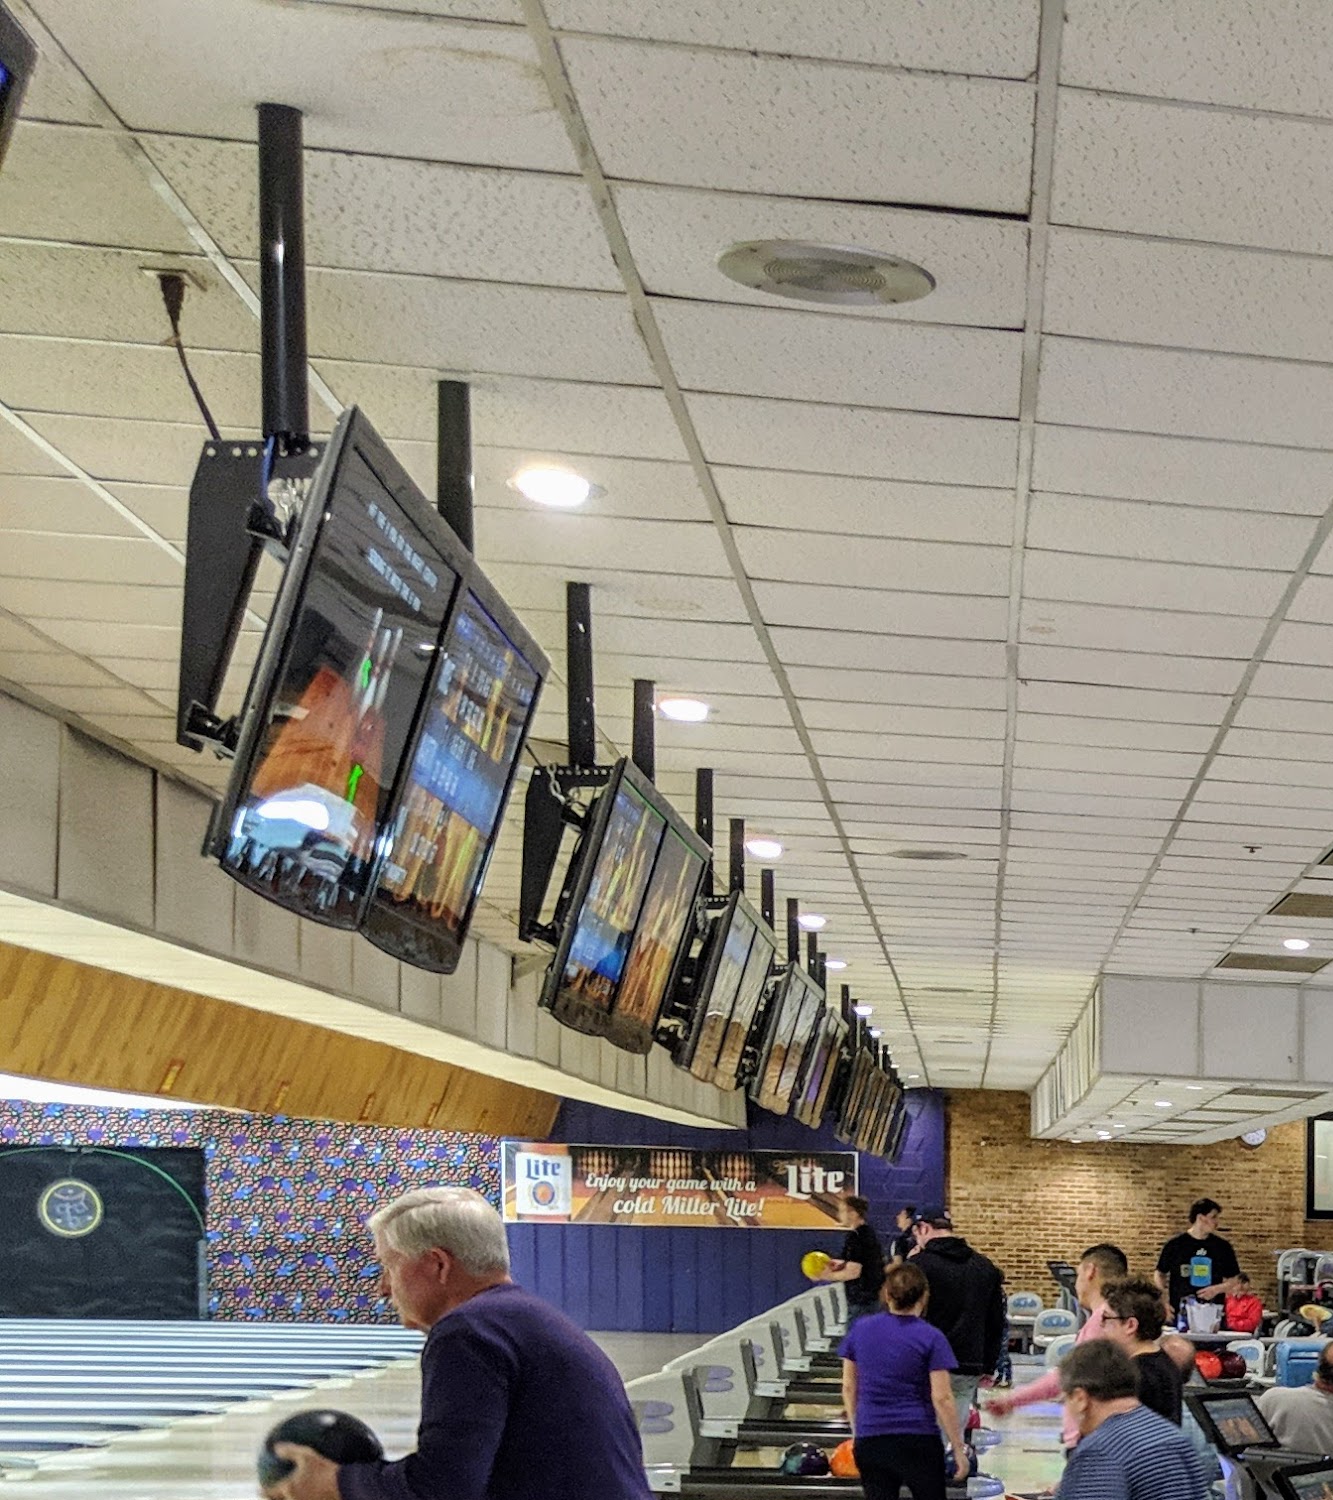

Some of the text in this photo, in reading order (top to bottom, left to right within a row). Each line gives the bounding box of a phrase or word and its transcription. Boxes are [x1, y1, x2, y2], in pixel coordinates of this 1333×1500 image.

[526, 1158, 561, 1180] Lite
[585, 1172, 757, 1193] Enjoy your game with a
[785, 1164, 845, 1200] Lite
[612, 1194, 765, 1222] cold Miller Lite!
